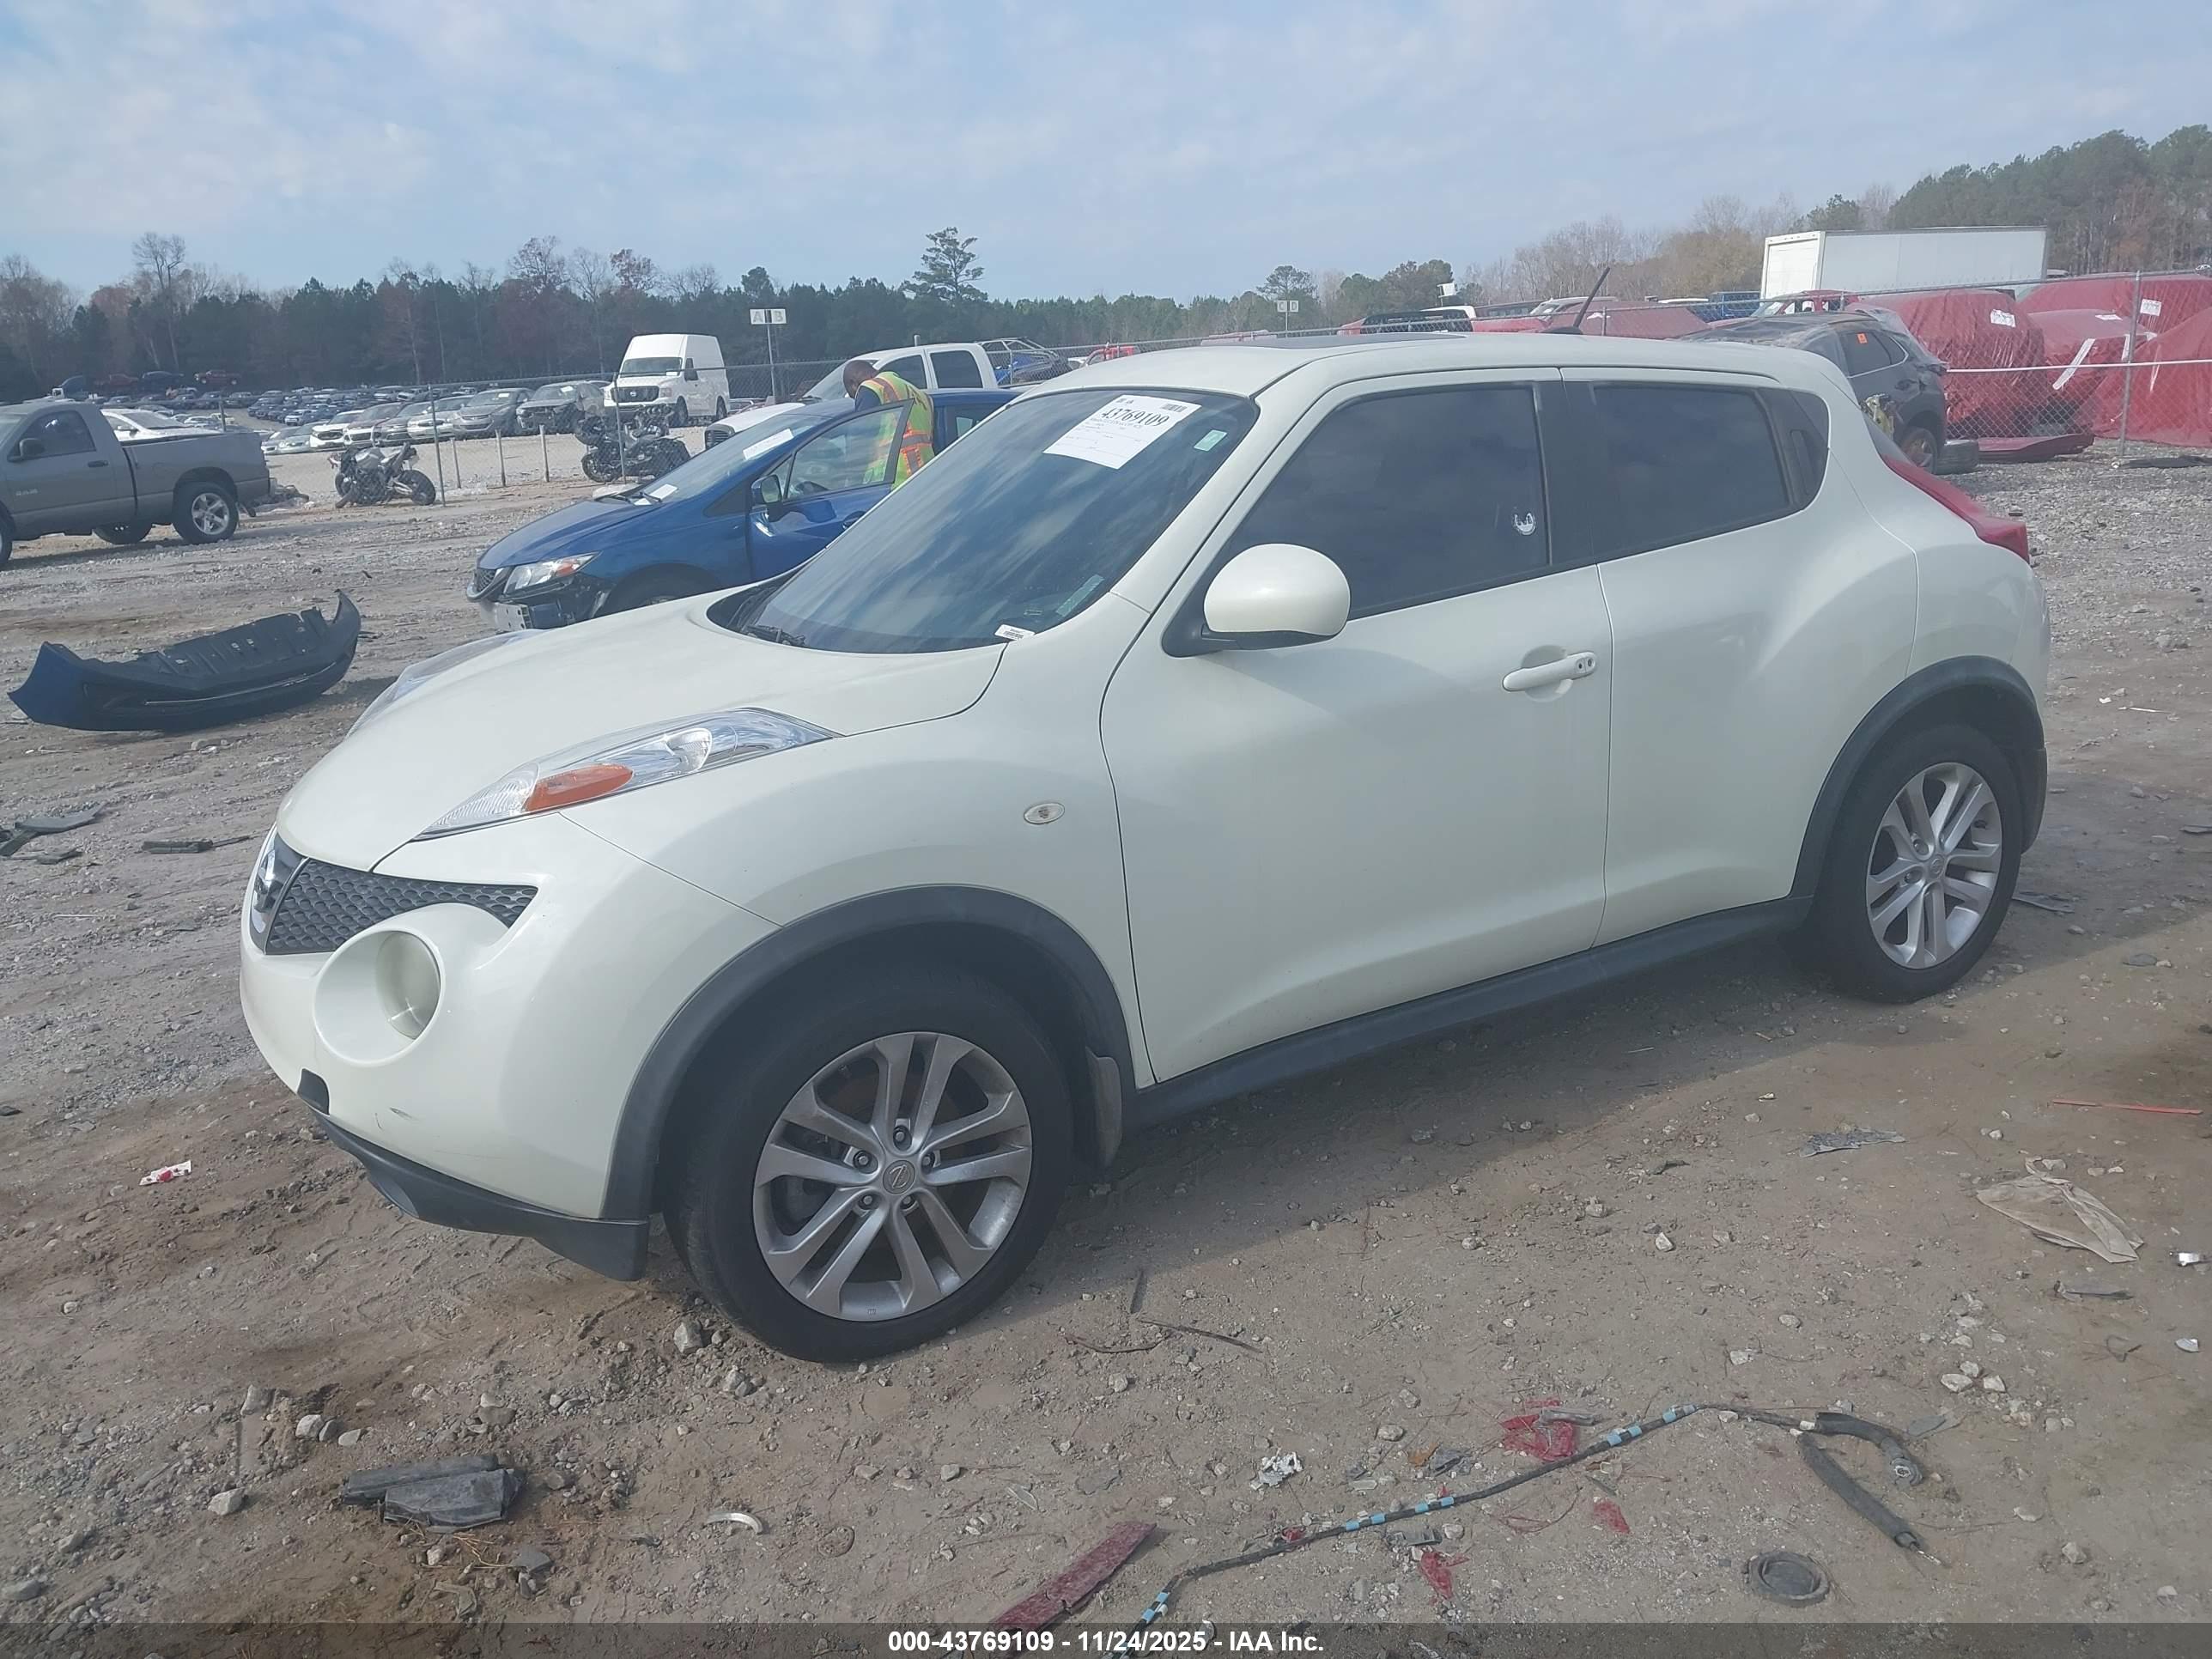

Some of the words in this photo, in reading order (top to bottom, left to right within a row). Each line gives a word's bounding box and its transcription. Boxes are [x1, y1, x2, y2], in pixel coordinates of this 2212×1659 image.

[753, 311, 763, 323] A
[775, 310, 784, 322] B
[1102, 407, 1170, 426] 43769109
